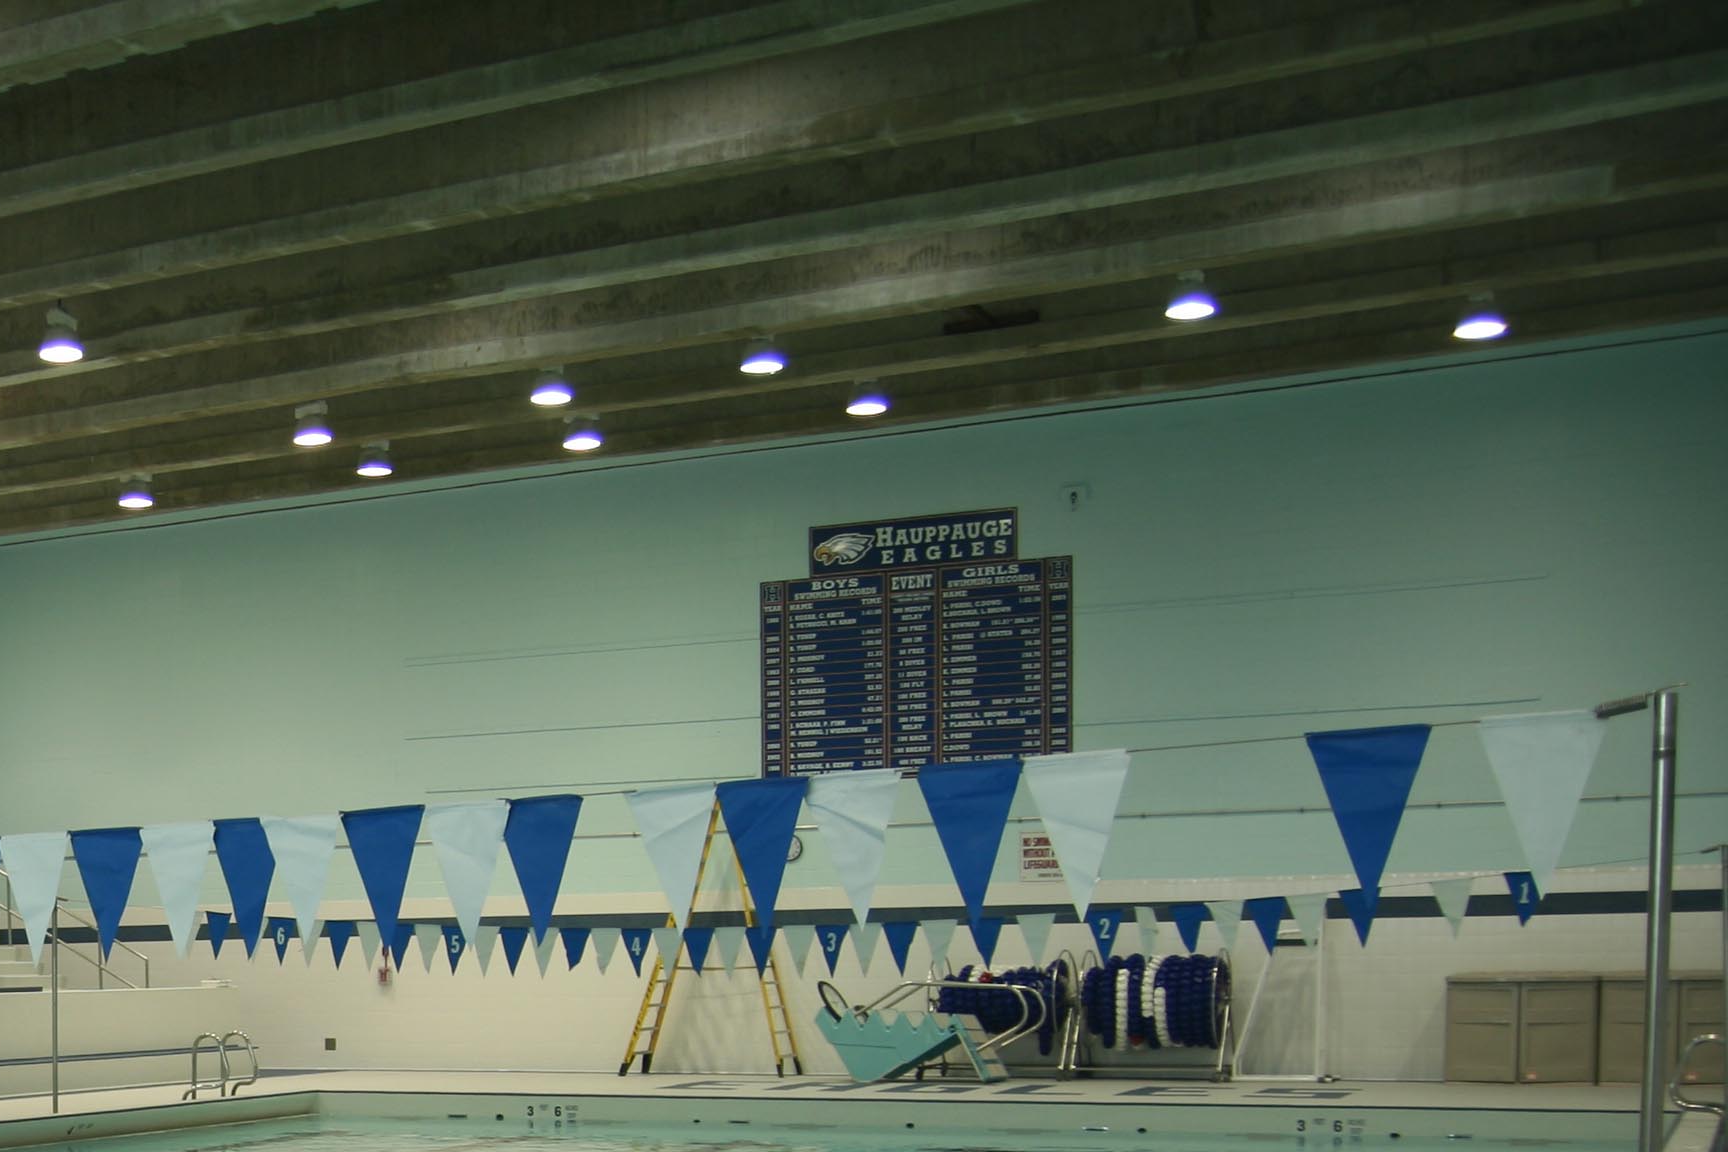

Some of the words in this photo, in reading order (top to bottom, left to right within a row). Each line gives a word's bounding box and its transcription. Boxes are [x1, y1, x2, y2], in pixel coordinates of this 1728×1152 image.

[875, 518, 1013, 547] HAUPPAUGE
[881, 540, 1007, 565] EAGLES
[962, 564, 1020, 578] GIRLS
[811, 577, 859, 591] BOYS
[891, 573, 933, 591] EVENT
[1519, 881, 1530, 904] 1
[276, 927, 285, 945] 6
[1099, 918, 1111, 939] 2
[451, 935, 460, 953] 5
[631, 936, 641, 956] 4
[826, 932, 837, 953] 3
[527, 1105, 534, 1117] 3
[554, 1105, 562, 1117] 6
[1296, 1119, 1306, 1132] 3
[1333, 1120, 1343, 1133] 6
